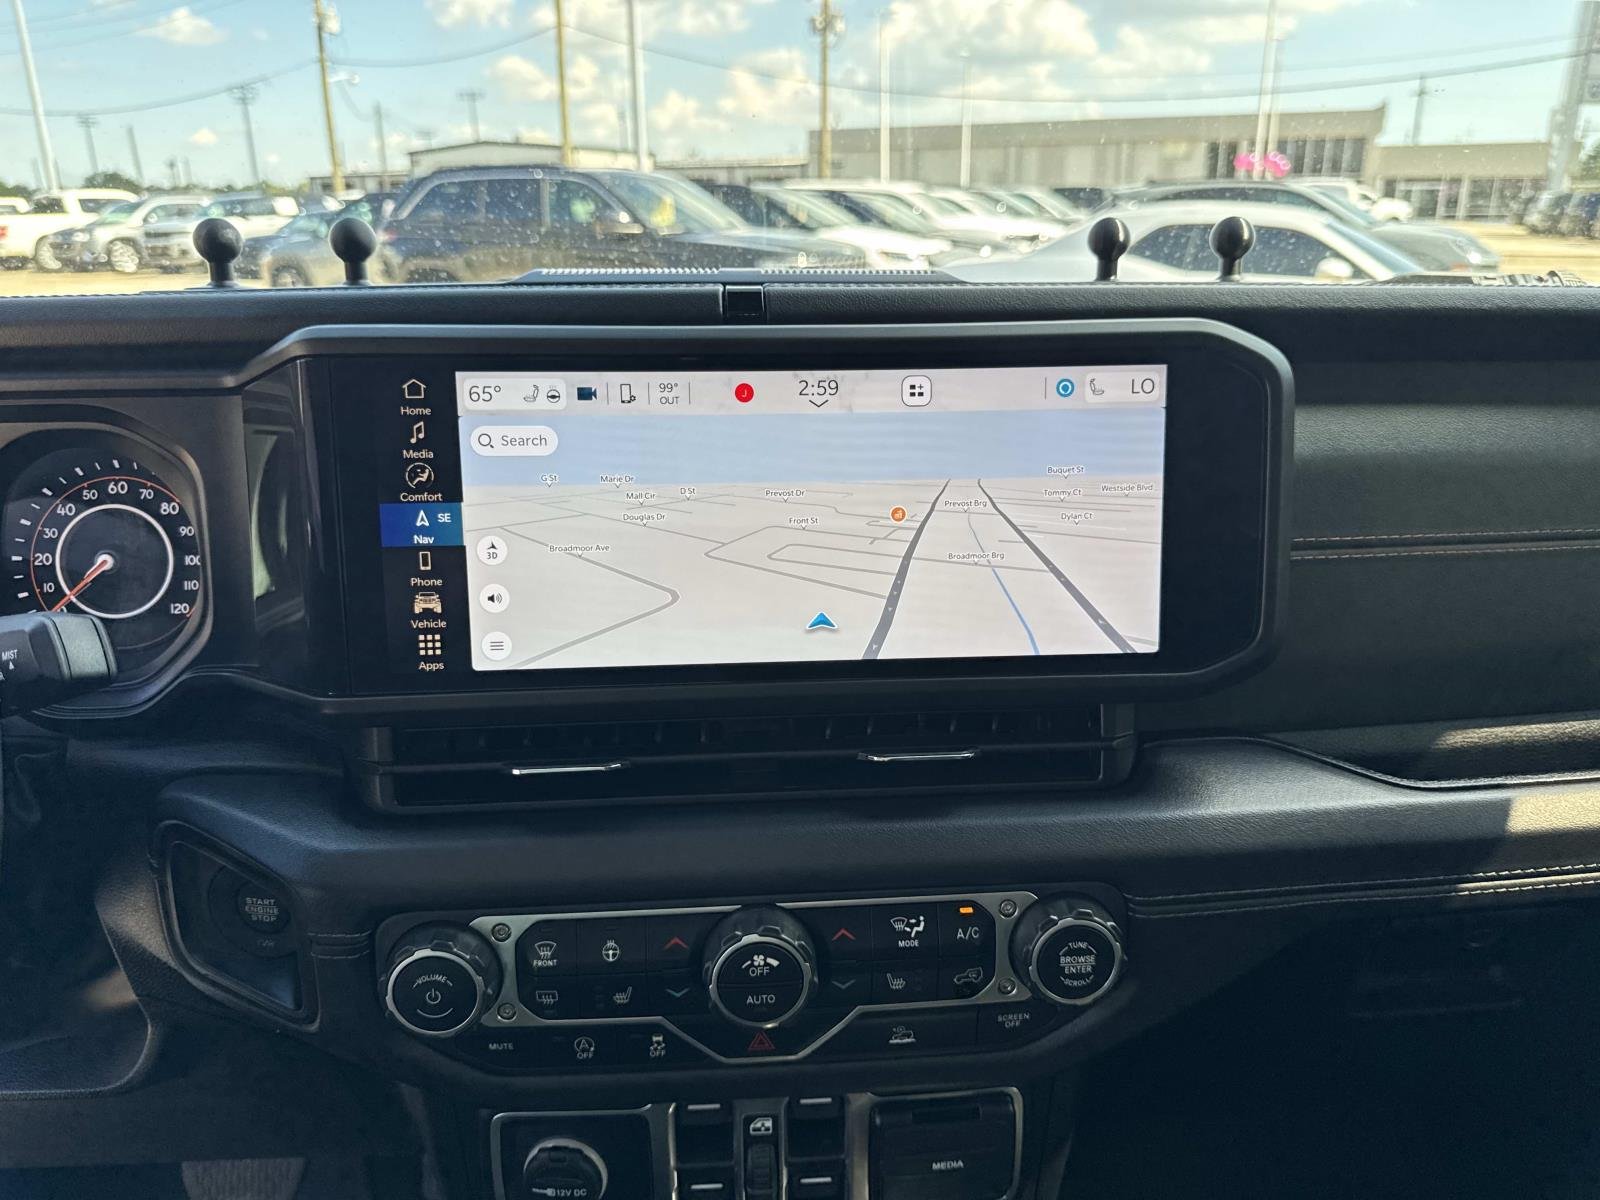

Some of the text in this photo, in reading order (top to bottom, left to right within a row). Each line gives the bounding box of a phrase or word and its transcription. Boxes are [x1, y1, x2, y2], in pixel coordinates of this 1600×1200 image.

[659, 382, 679, 393] 99°
[799, 380, 839, 396] 2:59
[1131, 379, 1154, 394] LO
[468, 385, 502, 402] 65°
[659, 396, 679, 405] OUT
[401, 406, 431, 416] Home
[501, 435, 548, 447] Search
[403, 449, 434, 459] Media
[1048, 466, 1074, 475] Buquet
[541, 474, 557, 482] G St
[108, 482, 128, 494] 60
[765, 488, 805, 498] Prevost Dr
[1044, 488, 1081, 498] Tommy Ct
[1102, 484, 1135, 492] Westside
[83, 490, 98, 499] 50
[139, 489, 154, 499] 70
[401, 492, 442, 502] Comfort
[626, 492, 656, 500] Mall Cir
[161, 502, 179, 515] 80
[944, 500, 987, 509] Prevost Brg
[57, 504, 75, 516] 40
[438, 514, 451, 522] SE
[623, 513, 654, 522] Douglas
[1061, 512, 1092, 521] Dylan Ct
[43, 529, 58, 538] 30
[180, 527, 194, 536] 90
[414, 535, 434, 544] Nav
[596, 544, 609, 552] Ave
[34, 554, 52, 565] 20
[948, 552, 1004, 561] Broadmoor Brg
[184, 581, 199, 590] 110
[411, 577, 442, 587] Phone
[43, 583, 54, 593] 10
[171, 604, 189, 614] 120
[411, 619, 446, 628] Vehicle
[1, 649, 18, 661] MIST
[419, 661, 444, 672] Apps
[245, 898, 275, 906] START
[245, 906, 279, 914] ENGINE
[251, 914, 276, 922] STOP
[957, 927, 980, 939] A/C
[898, 939, 919, 948] MODE
[1069, 941, 1088, 950] TUNE
[533, 959, 557, 967] FRONT
[1060, 954, 1095, 964] BROWSE
[749, 966, 770, 976] OFF
[1064, 964, 1092, 974] ENTER
[416, 974, 448, 985] VOLUME
[1063, 978, 1091, 987] SCROLL
[747, 995, 775, 1005] AUTO
[998, 1012, 1030, 1022] SCREEN
[1005, 1020, 1020, 1028] OFF
[489, 1042, 514, 1051] MUTE
[932, 1160, 964, 1170] MEDIA
